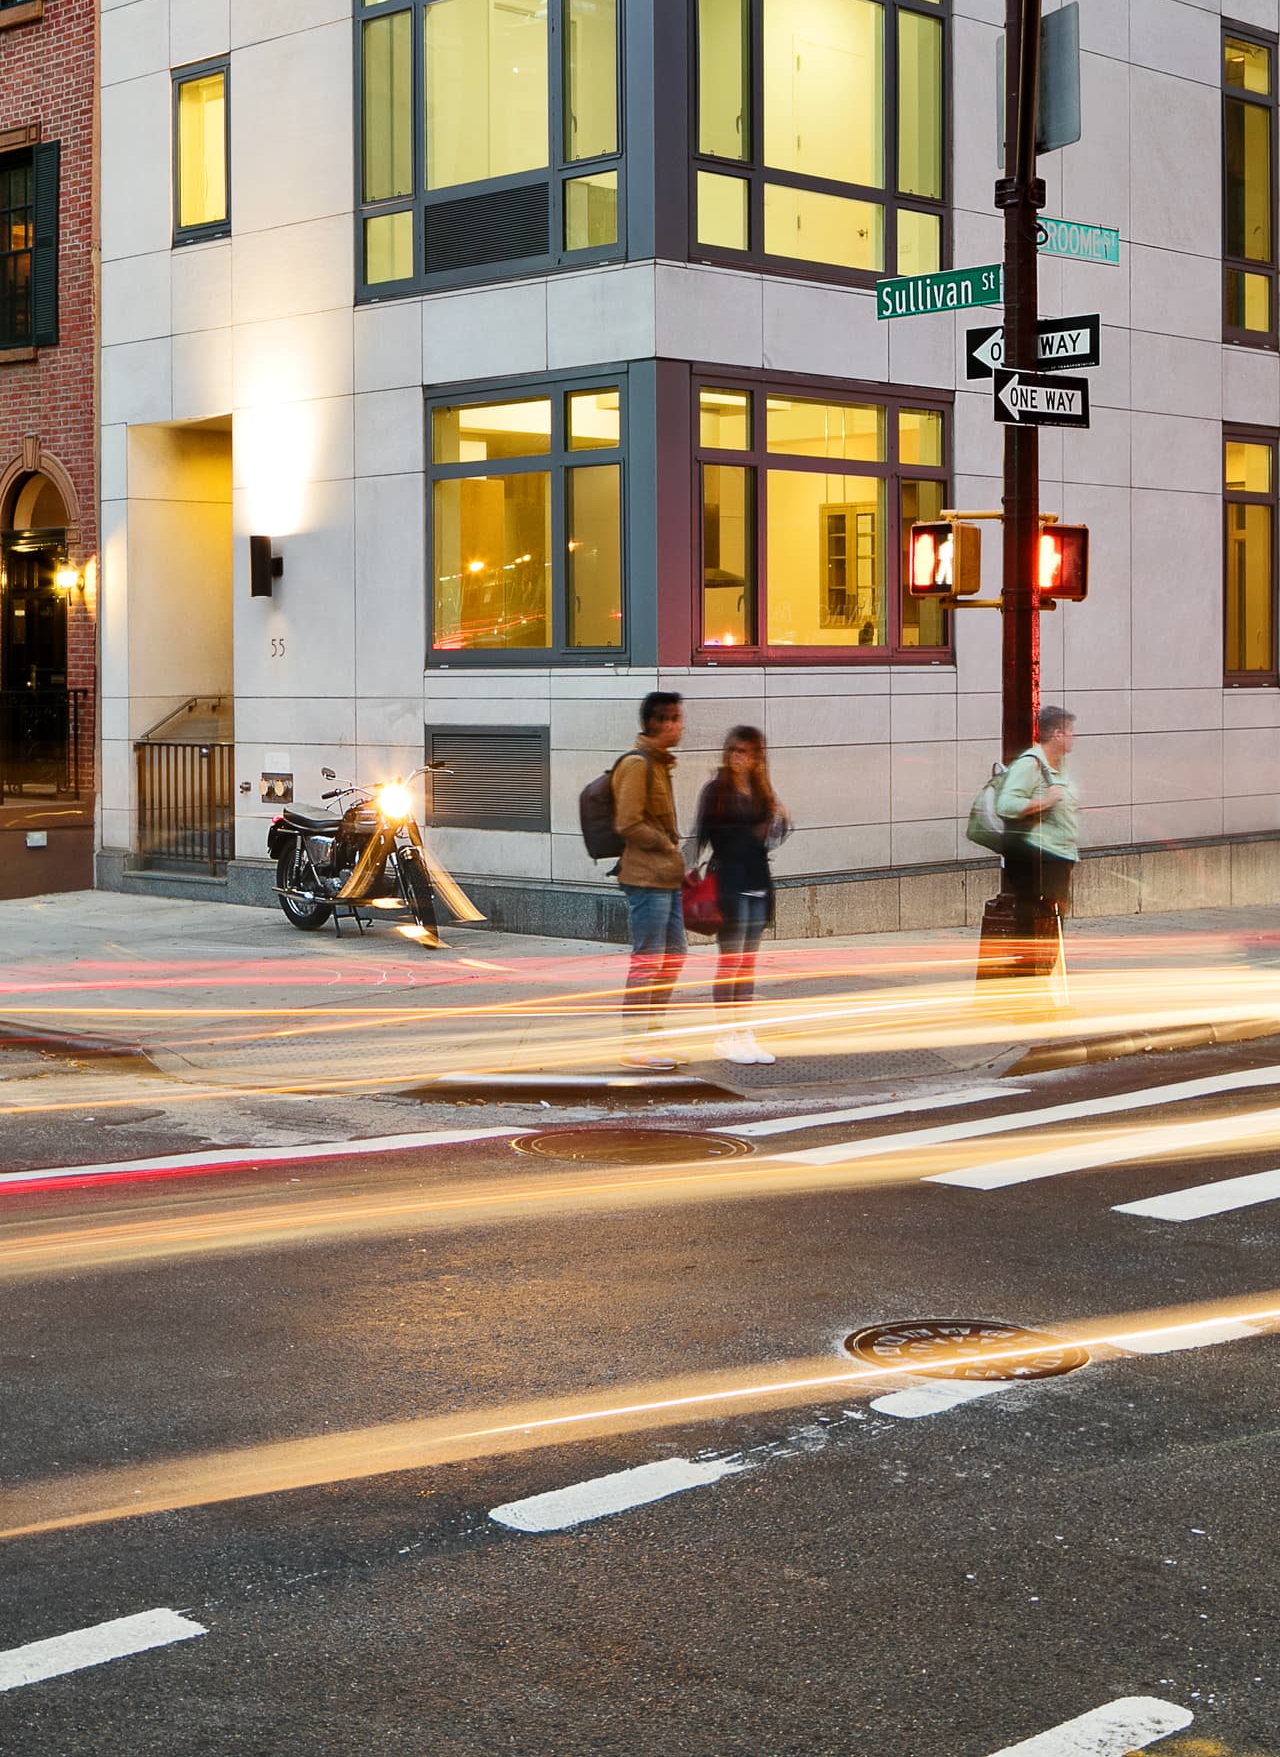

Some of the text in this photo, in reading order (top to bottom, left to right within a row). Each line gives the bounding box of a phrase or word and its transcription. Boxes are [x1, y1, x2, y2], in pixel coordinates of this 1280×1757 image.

[882, 271, 995, 316] Sullivan St
[1040, 332, 1081, 357] WAY
[1010, 387, 1075, 412] ONE WAY
[271, 638, 286, 658] 55
